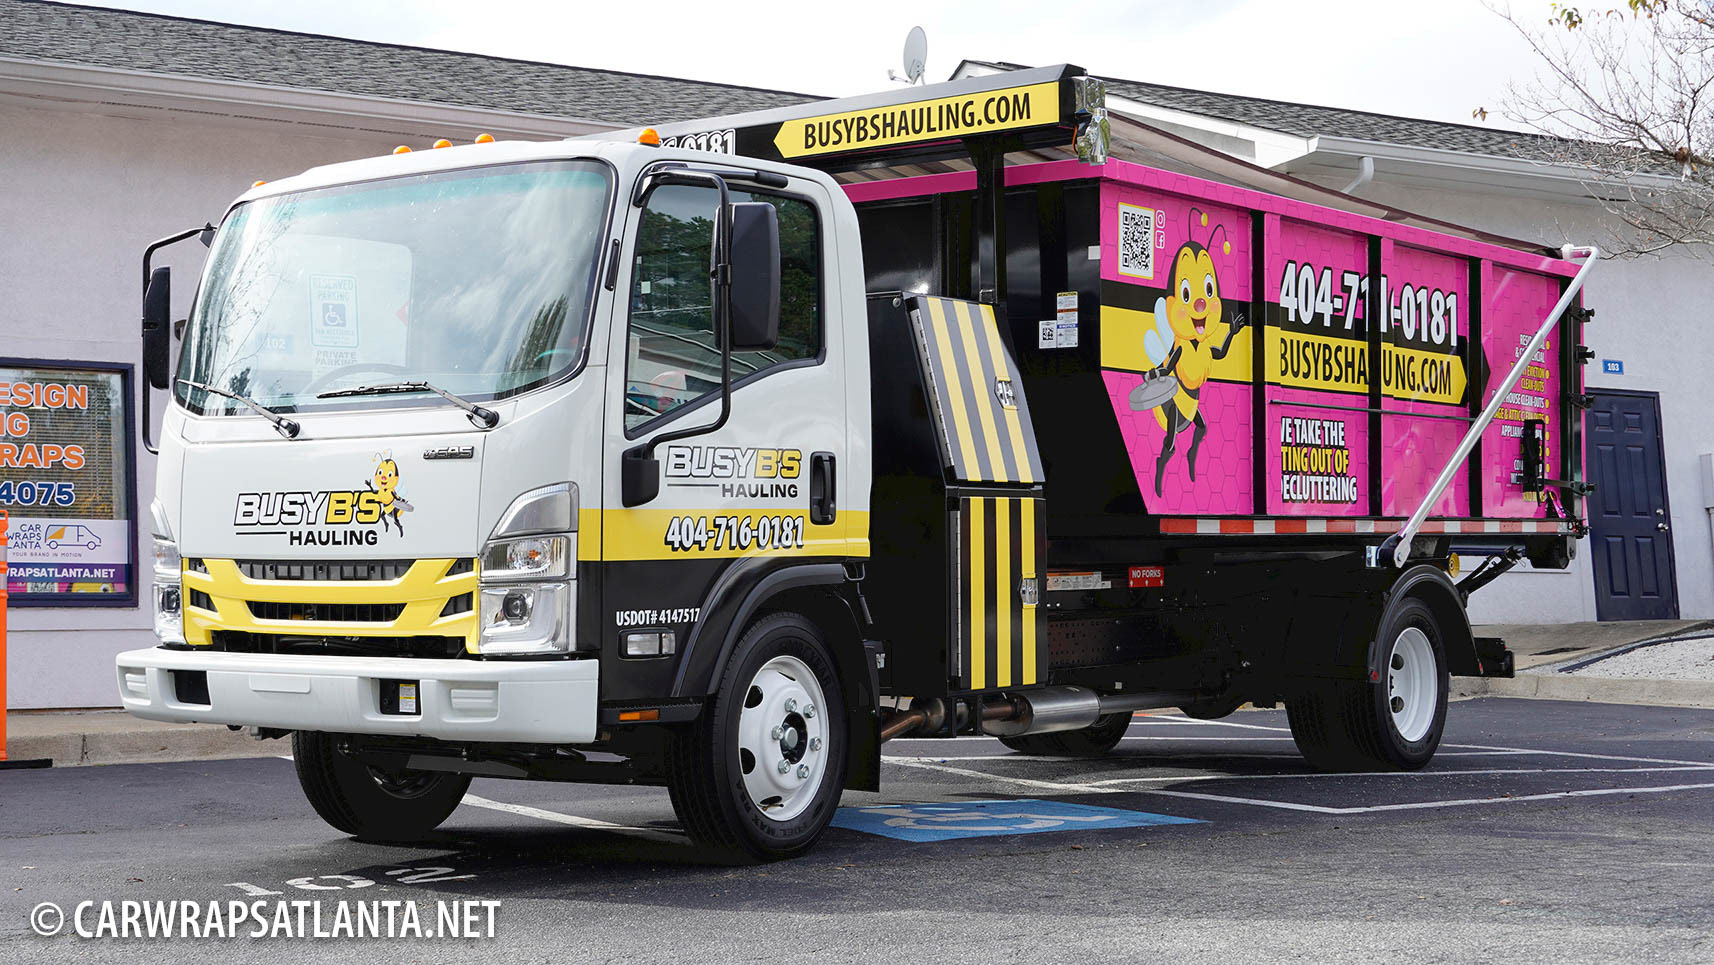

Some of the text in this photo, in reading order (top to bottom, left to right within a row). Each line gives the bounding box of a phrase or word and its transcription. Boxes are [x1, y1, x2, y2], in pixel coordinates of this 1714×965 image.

[803, 92, 1032, 149] BUSYBSHAULING.COM
[316, 350, 357, 360] PRIVATE
[1294, 418, 1322, 445] TAKE
[1322, 420, 1345, 447] THE
[1310, 447, 1333, 474] OUT
[1334, 449, 1350, 475] OF
[721, 483, 799, 498] HAULING
[1281, 474, 1358, 502] ECLUTTERING
[20, 523, 42, 533] CAR
[664, 515, 805, 551] 404-716-0181
[8, 541, 42, 550] ANTA
[289, 530, 378, 546] HAULING
[1131, 569, 1161, 579] NO FORKS
[616, 607, 701, 626] USDOT# 4147517
[222, 866, 479, 897] 102
